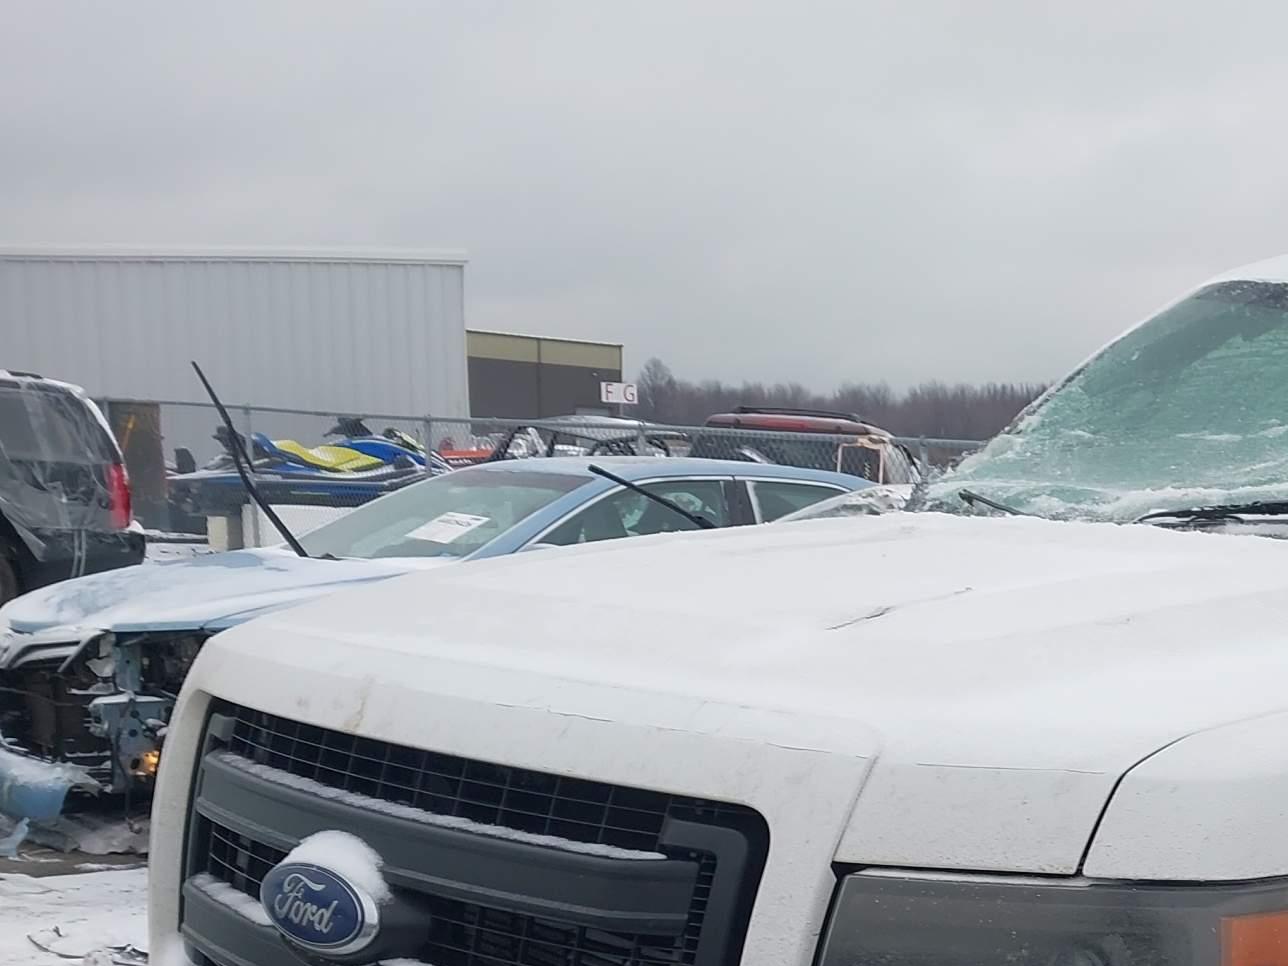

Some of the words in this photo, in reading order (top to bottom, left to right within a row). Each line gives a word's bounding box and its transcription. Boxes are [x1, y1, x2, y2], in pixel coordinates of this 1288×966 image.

[604, 383, 615, 401] F
[623, 384, 635, 402] G
[274, 873, 339, 933] Ford
